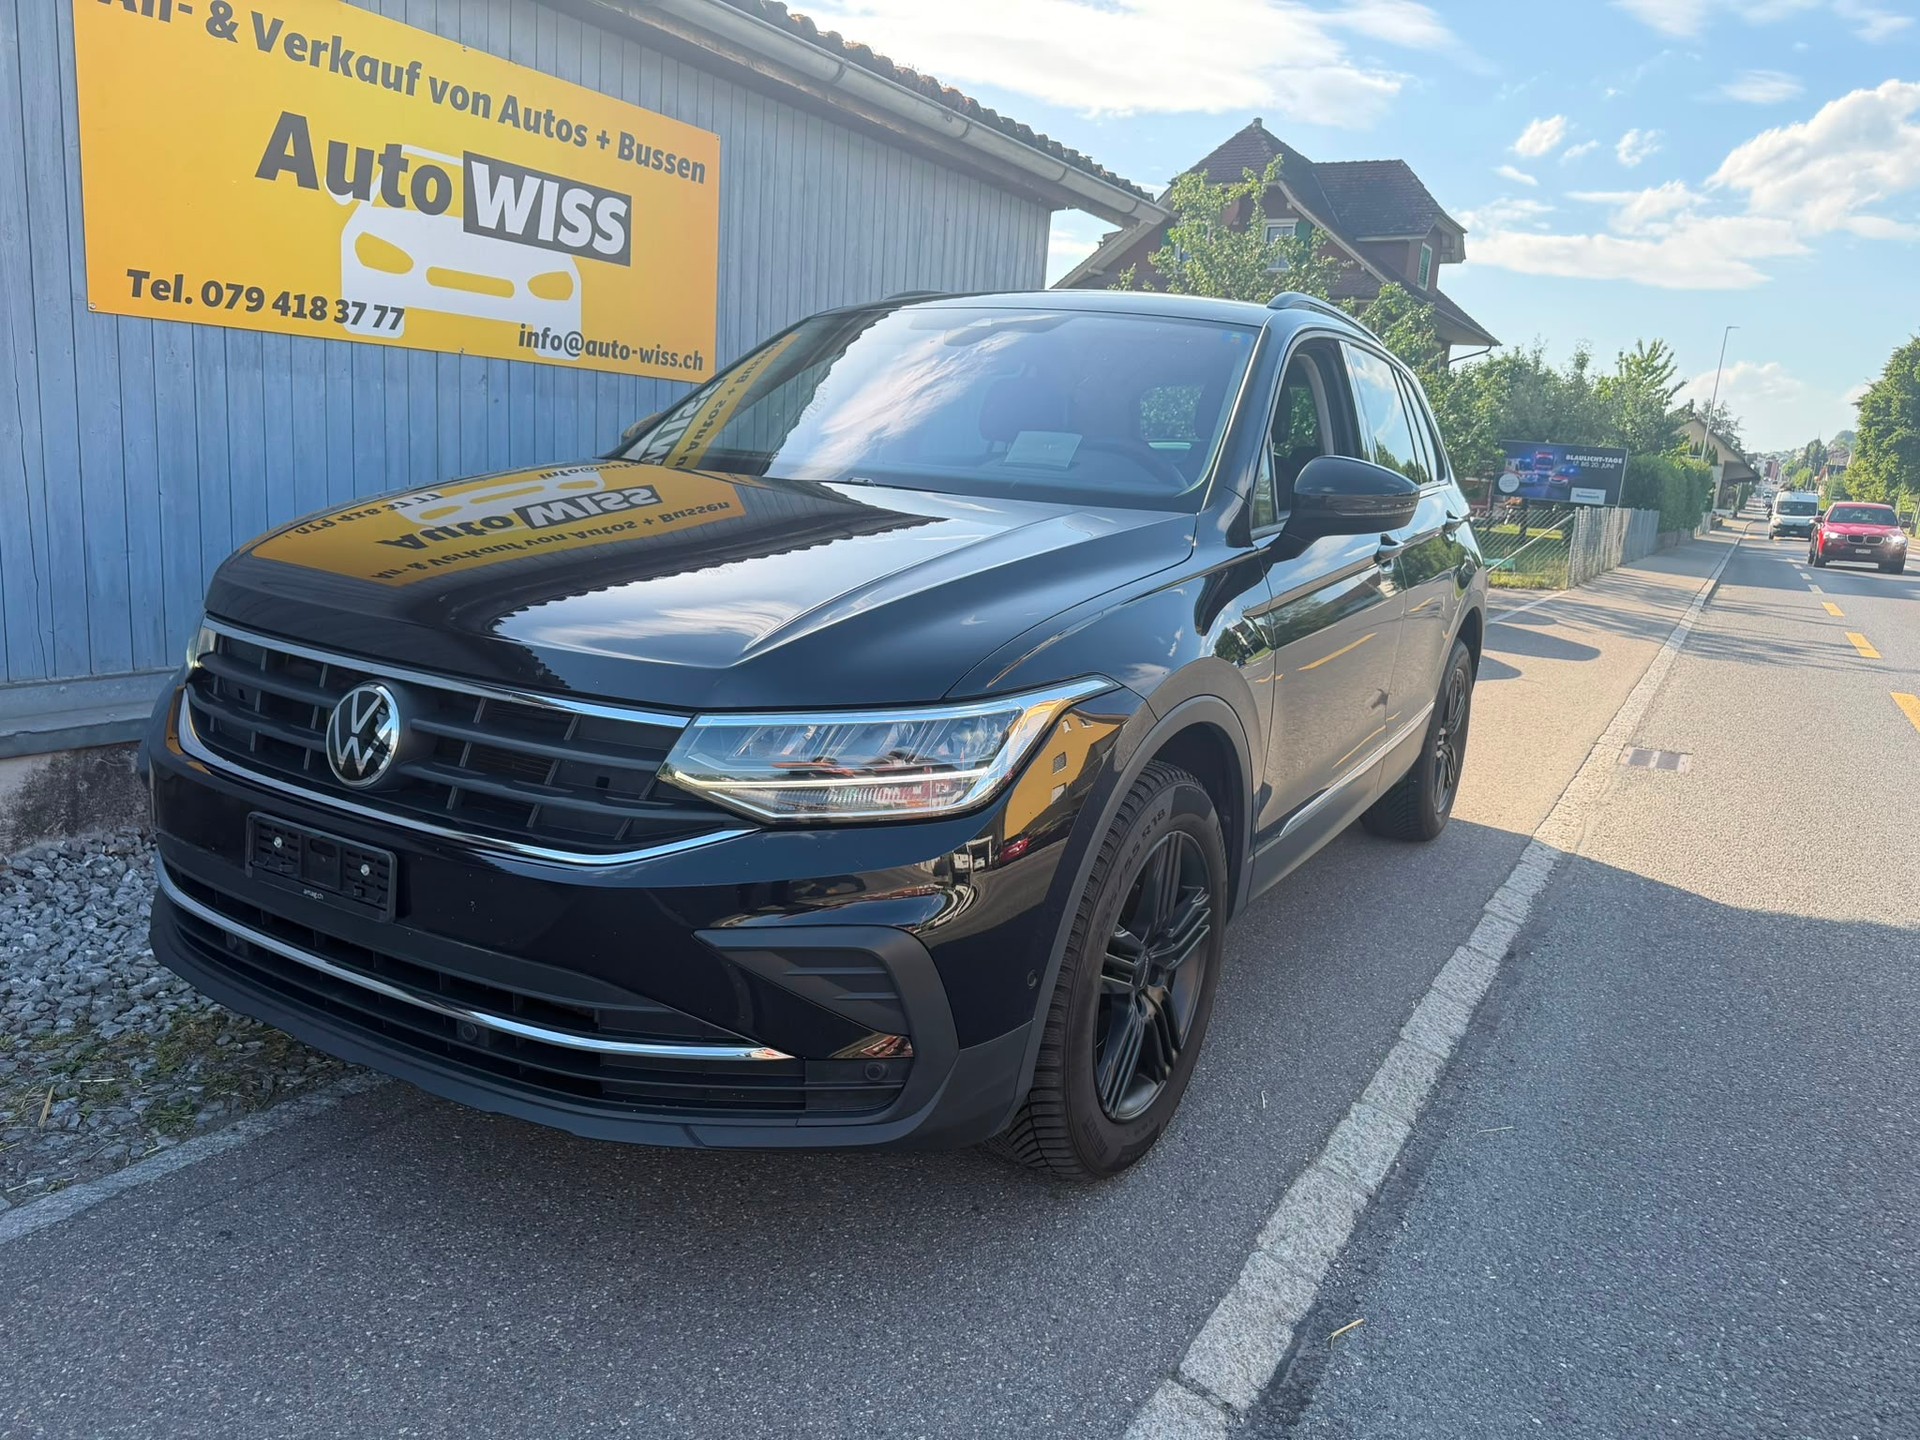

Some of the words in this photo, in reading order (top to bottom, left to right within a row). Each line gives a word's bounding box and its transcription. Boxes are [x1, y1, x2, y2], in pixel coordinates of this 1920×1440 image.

[205, 0, 239, 43] &
[250, 10, 422, 97] Verkauf
[429, 75, 492, 119] von
[498, 101, 588, 148] Autos
[596, 130, 610, 150] +
[617, 131, 707, 184] Bussen
[254, 111, 453, 216] Auto
[471, 160, 627, 256] WISS
[126, 268, 193, 305] Tel.
[201, 280, 265, 313] 079
[271, 291, 328, 322] 418
[334, 299, 368, 327] 37
[371, 304, 405, 331] 77
[518, 322, 704, 372] info@auto-wiss.ch
[1565, 454, 1623, 464] BLAULICHT-TAGE
